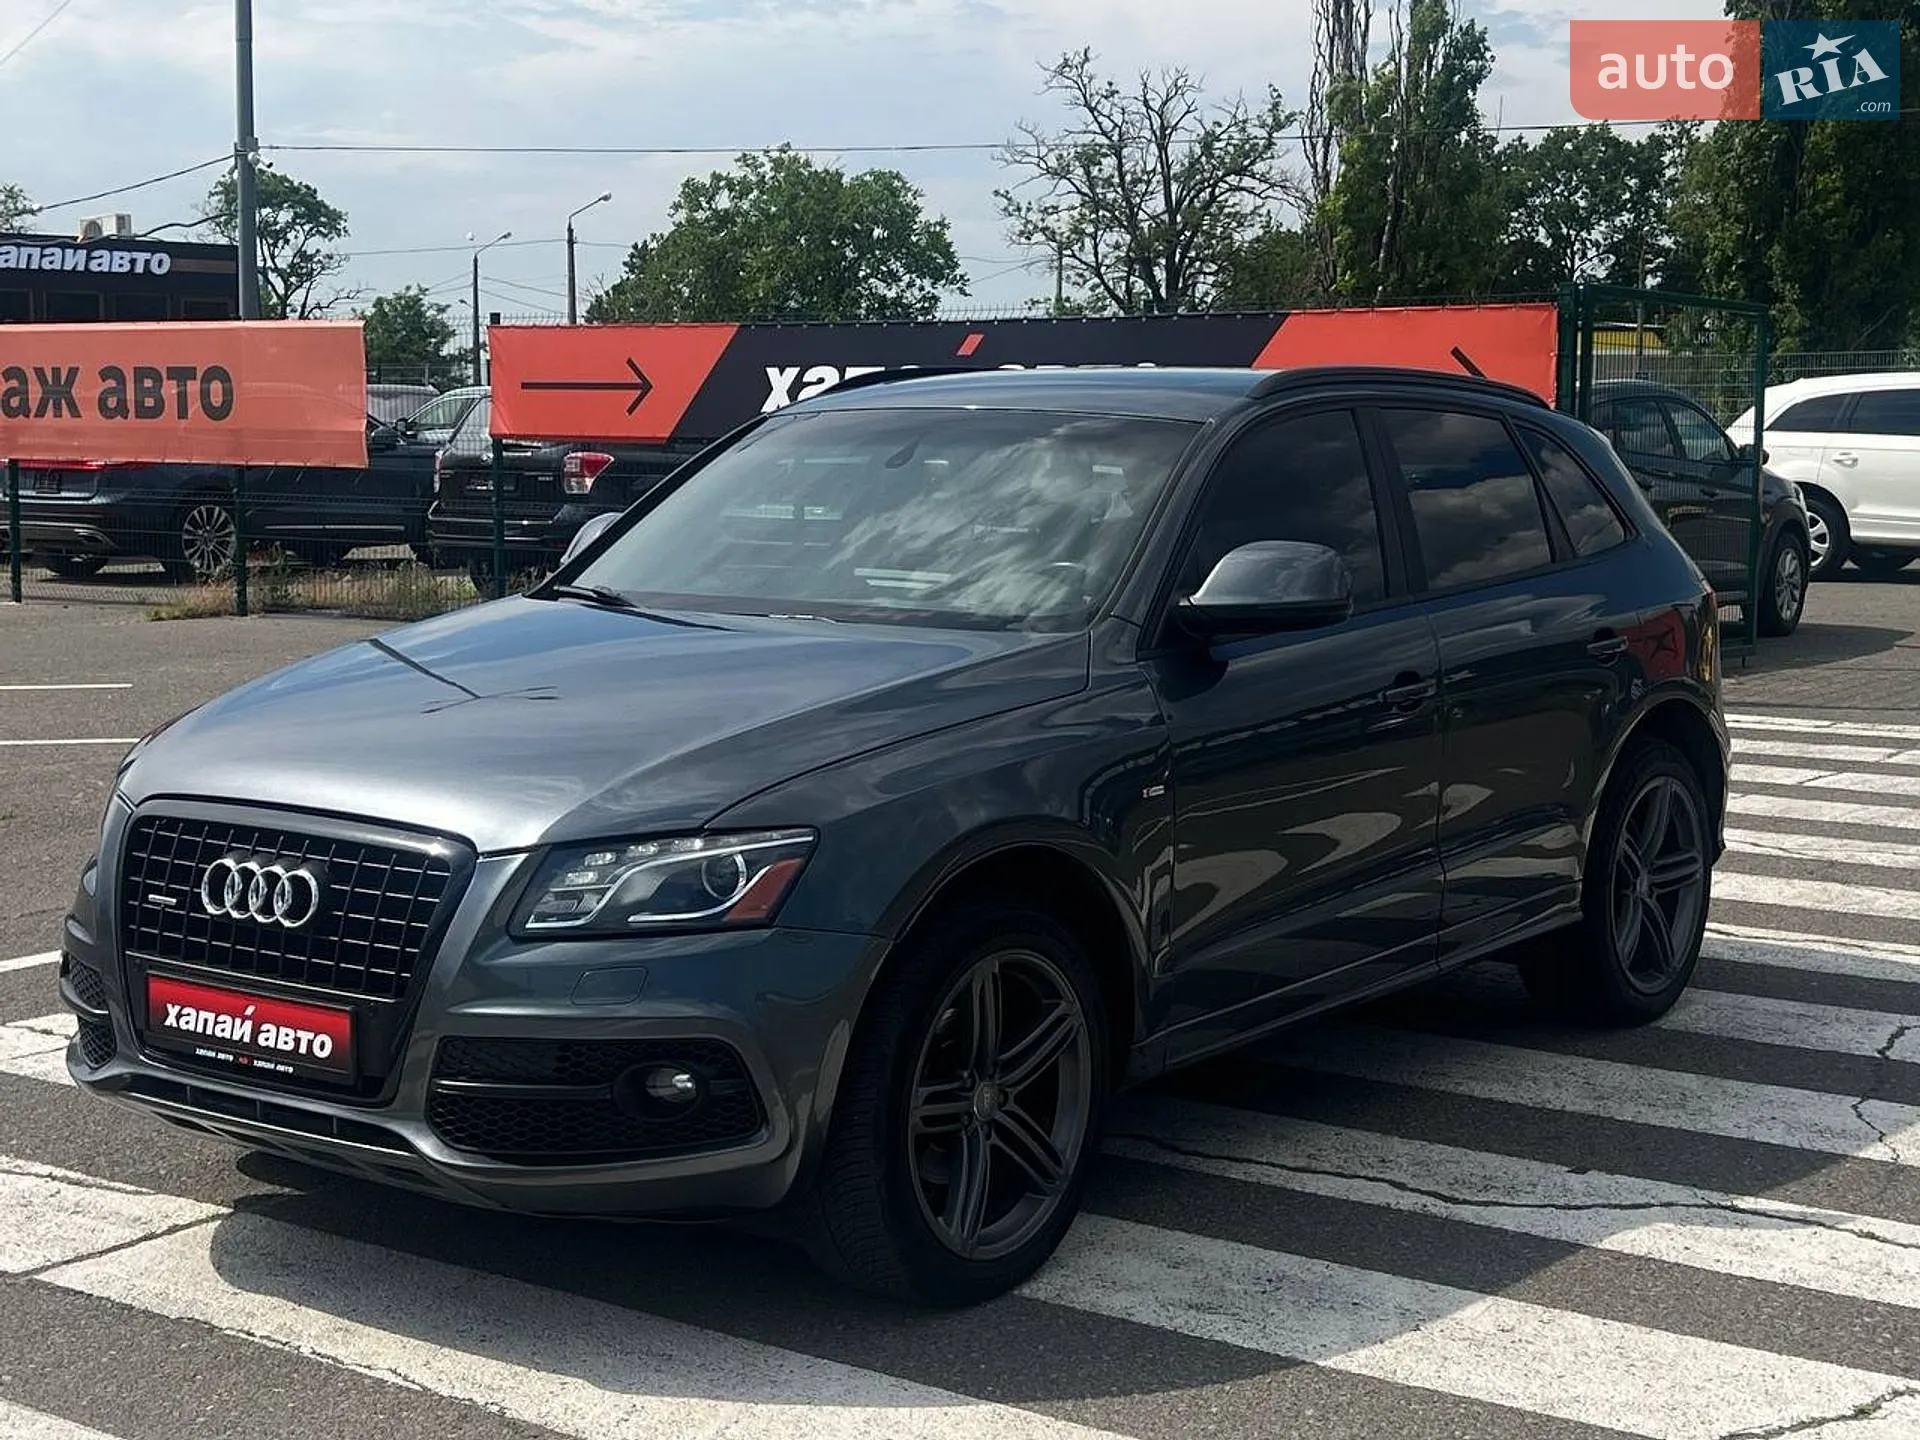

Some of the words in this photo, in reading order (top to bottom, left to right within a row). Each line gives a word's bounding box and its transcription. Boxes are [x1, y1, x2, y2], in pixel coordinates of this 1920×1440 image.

[87, 249, 171, 275] авто
[1, 366, 82, 419] аж
[97, 365, 234, 421] авто
[164, 1003, 256, 1043] хапай
[257, 1022, 333, 1059] авто
